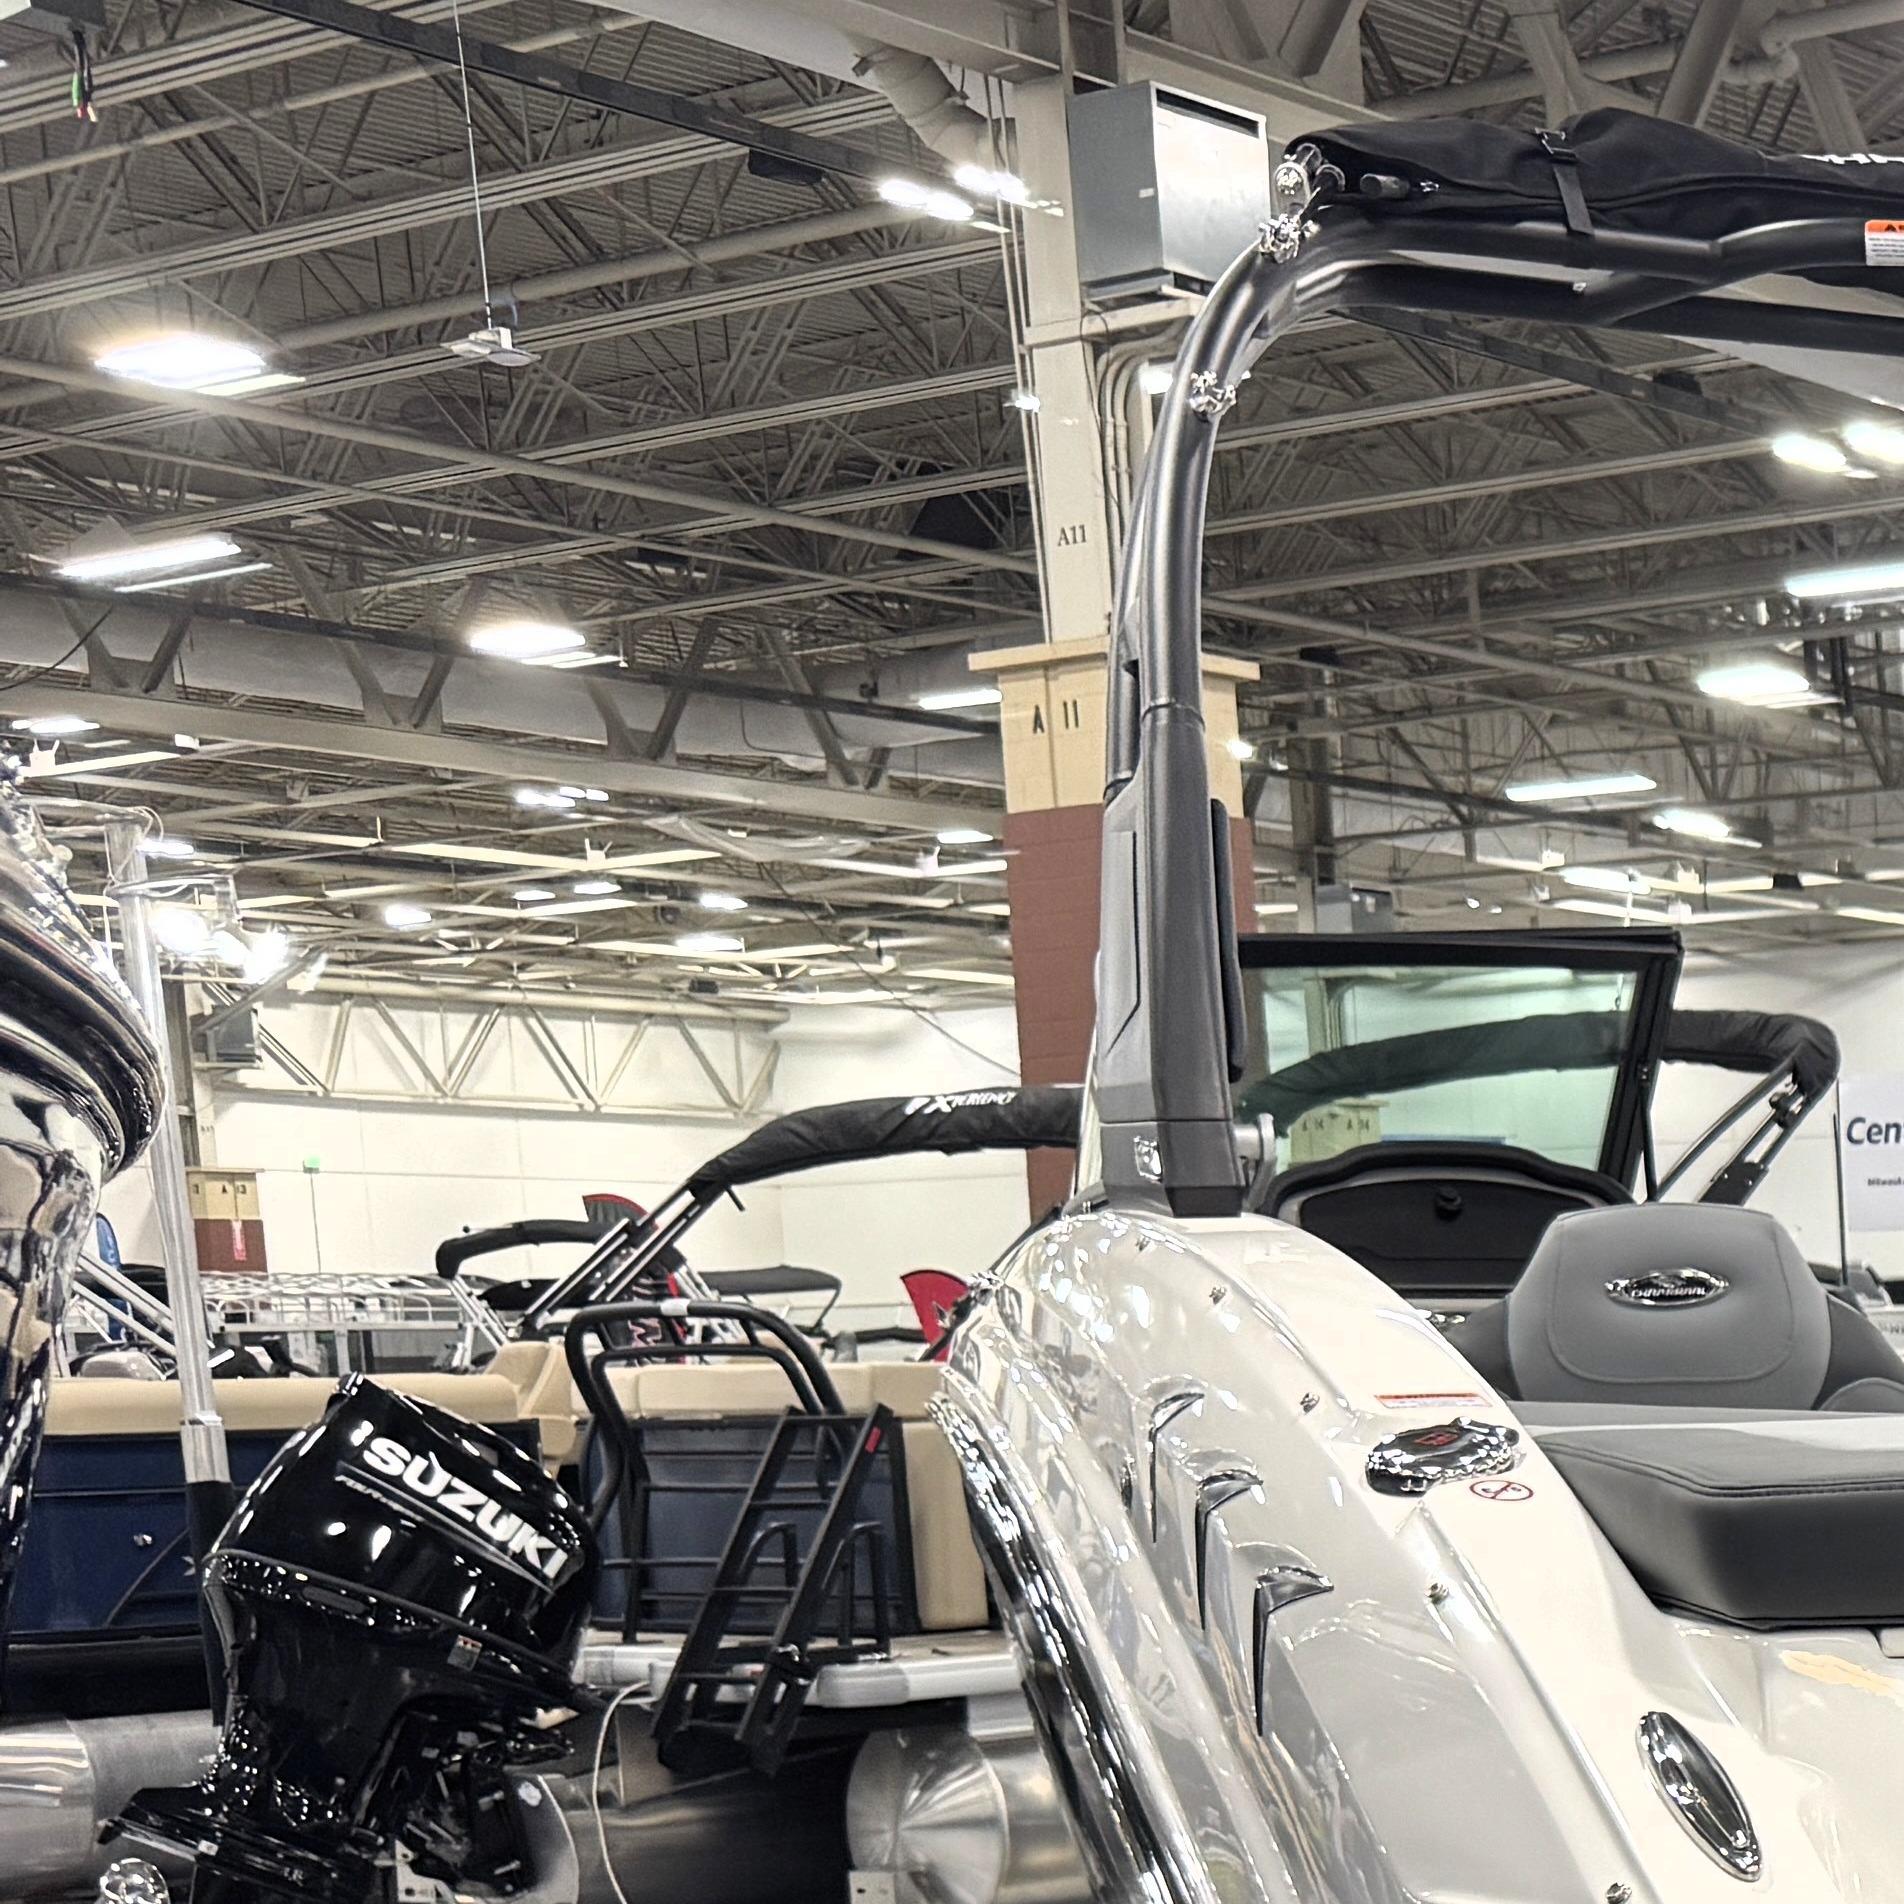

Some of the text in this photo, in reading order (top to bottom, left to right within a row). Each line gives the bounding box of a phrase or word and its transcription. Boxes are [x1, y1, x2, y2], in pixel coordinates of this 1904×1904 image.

[1057, 524, 1087, 547] A11
[1032, 704, 1045, 734] A
[363, 1436, 569, 1579] SUZUKI
